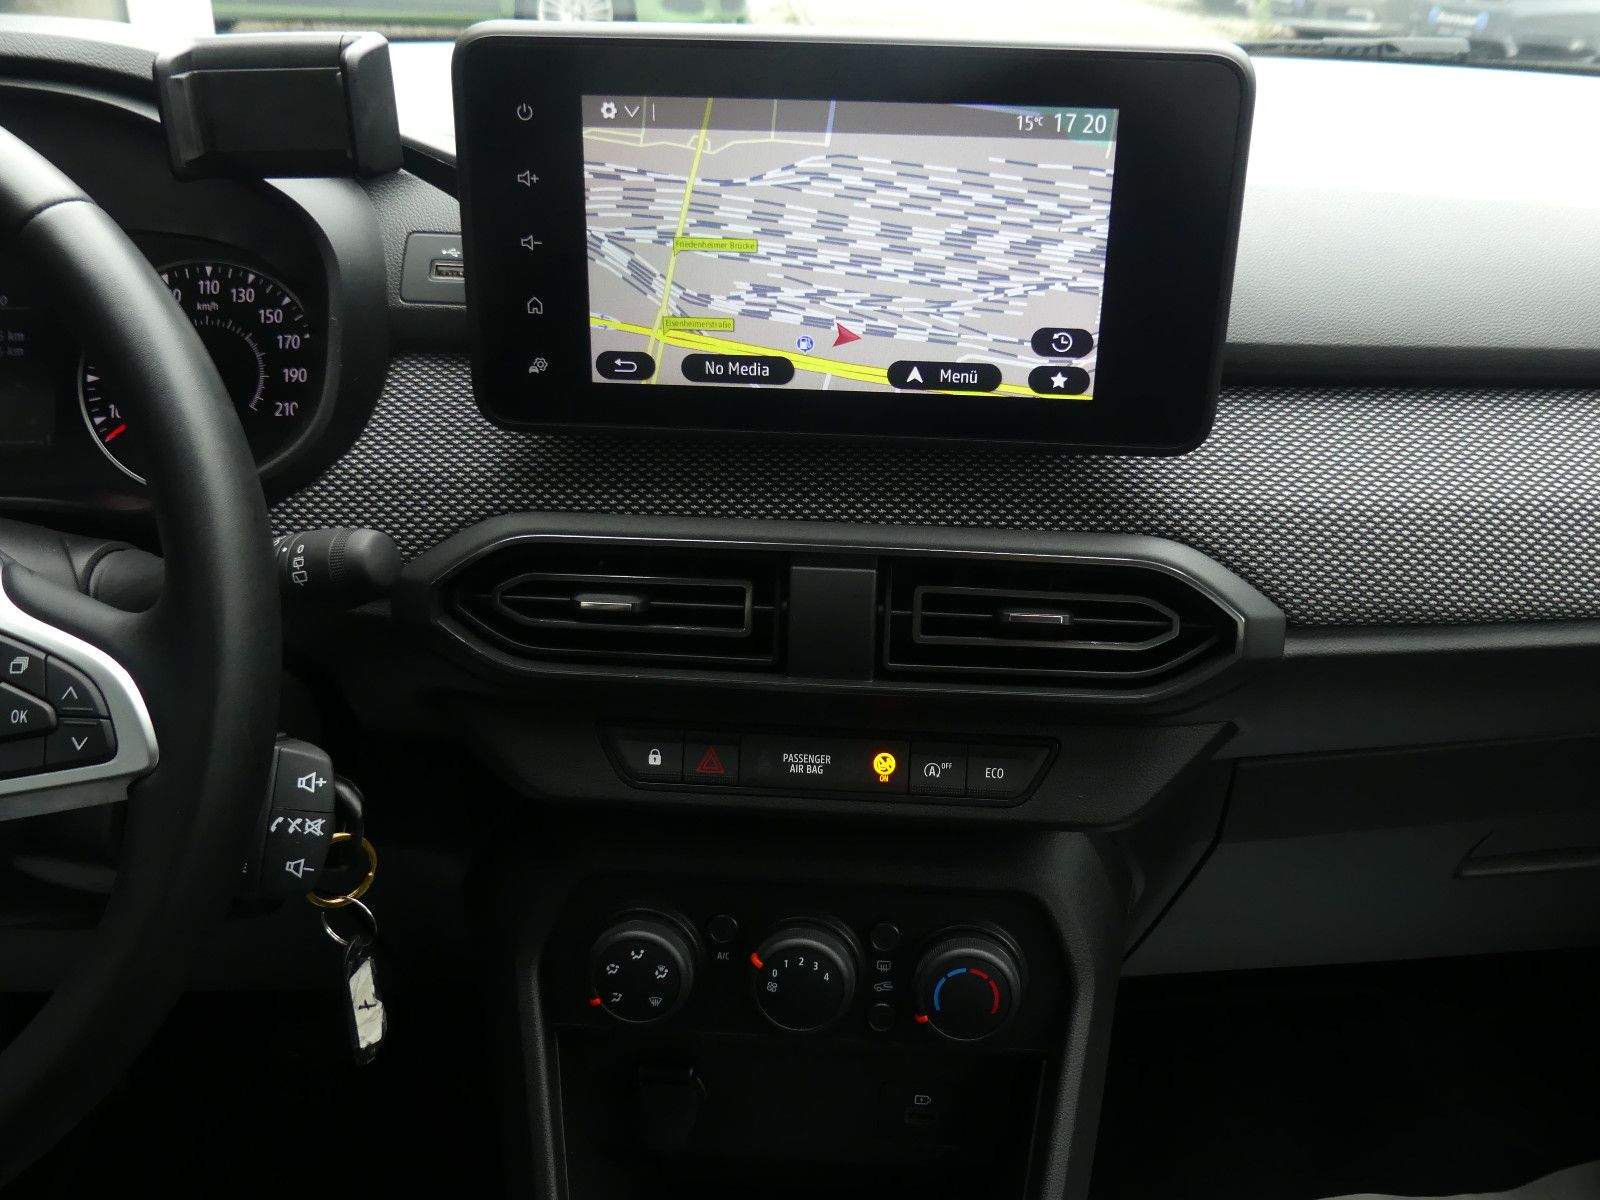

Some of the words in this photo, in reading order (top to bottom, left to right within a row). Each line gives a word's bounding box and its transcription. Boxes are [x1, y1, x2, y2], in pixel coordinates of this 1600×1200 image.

[1054, 113, 1077, 133] 17
[1082, 114, 1107, 134] 20
[198, 280, 220, 295] 110
[230, 288, 255, 303] 130
[196, 301, 219, 311] km/h
[258, 309, 283, 324] 150
[277, 334, 301, 350] 170
[705, 360, 724, 375] No
[728, 361, 770, 377] Media
[283, 368, 308, 383] 190
[940, 368, 978, 384] Menü
[10, 709, 28, 724] OK
[782, 753, 831, 764] PASSENGER
[789, 764, 804, 773] AIR
[806, 764, 824, 775] BAG
[941, 762, 953, 770] OFF
[879, 774, 889, 783] ON
[985, 767, 1005, 779] ECO
[784, 960, 789, 968] 1
[798, 957, 805, 966] 2
[813, 961, 819, 971] 3
[772, 969, 778, 978] 0
[823, 972, 830, 982] 4
